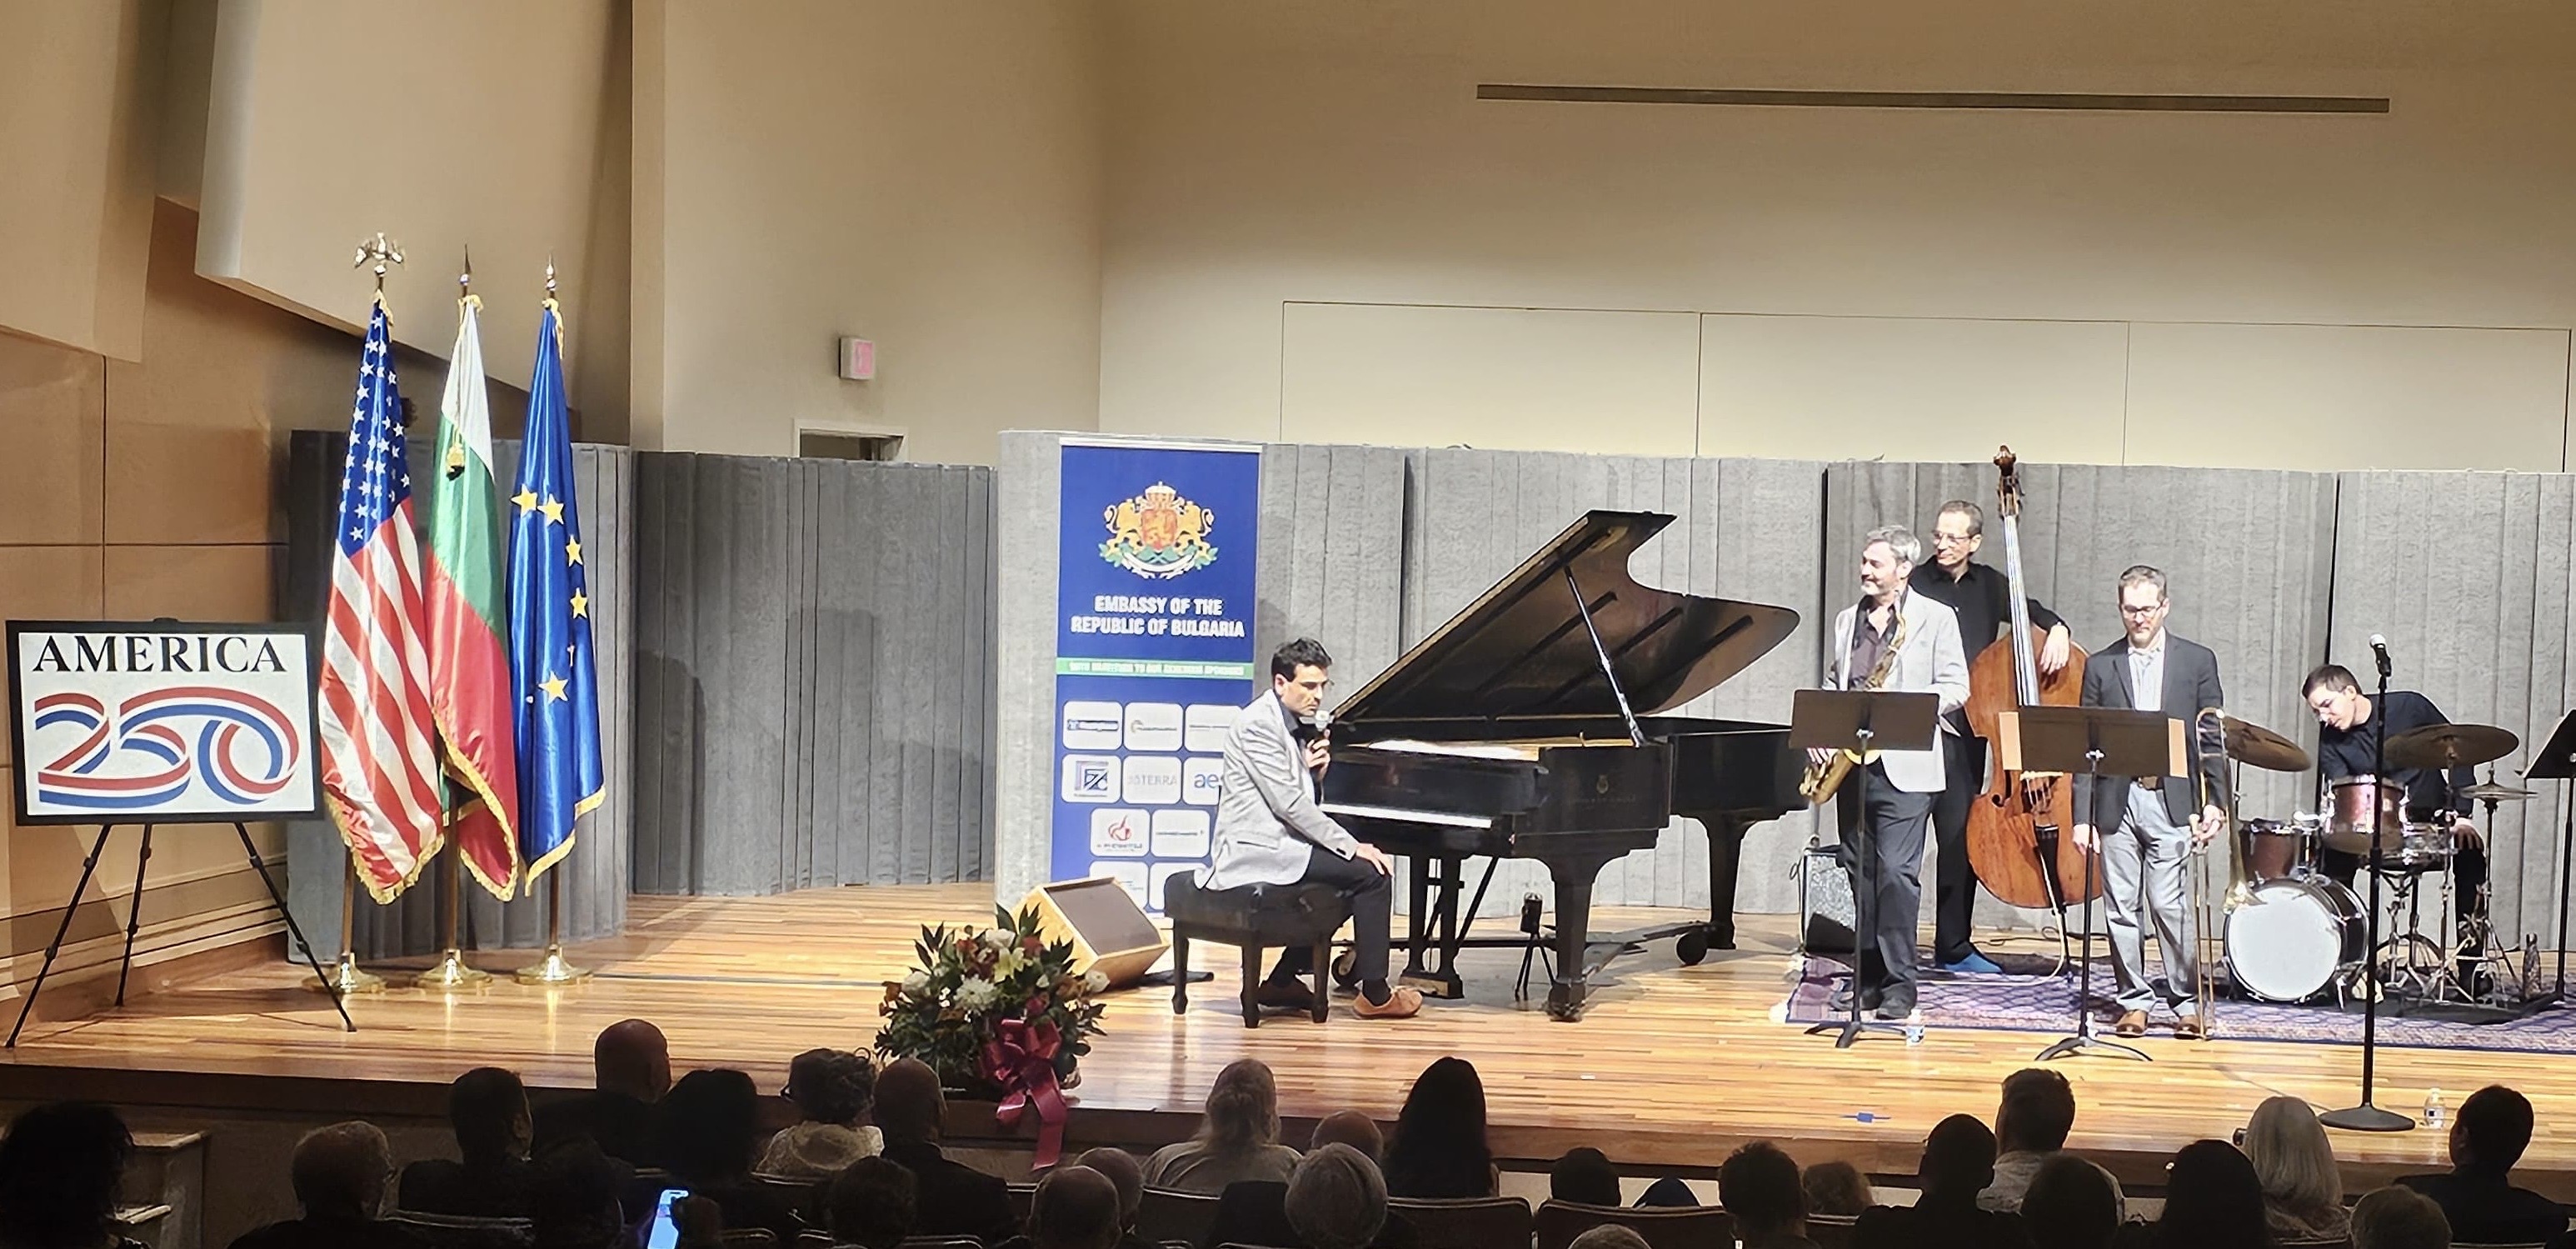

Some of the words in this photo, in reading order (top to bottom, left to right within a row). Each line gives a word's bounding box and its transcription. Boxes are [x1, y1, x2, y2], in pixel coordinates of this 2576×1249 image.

[1094, 595, 1167, 614] EMBASSY
[1170, 597, 1191, 615] OF
[1193, 598, 1223, 616] THE
[1071, 615, 1146, 635] REPUBLIC
[1147, 617, 1168, 636] OF
[1170, 619, 1246, 637] BULGARIA
[32, 635, 287, 672] AMERICA
[34, 686, 300, 809] 250
[1193, 773, 1220, 789] ae
